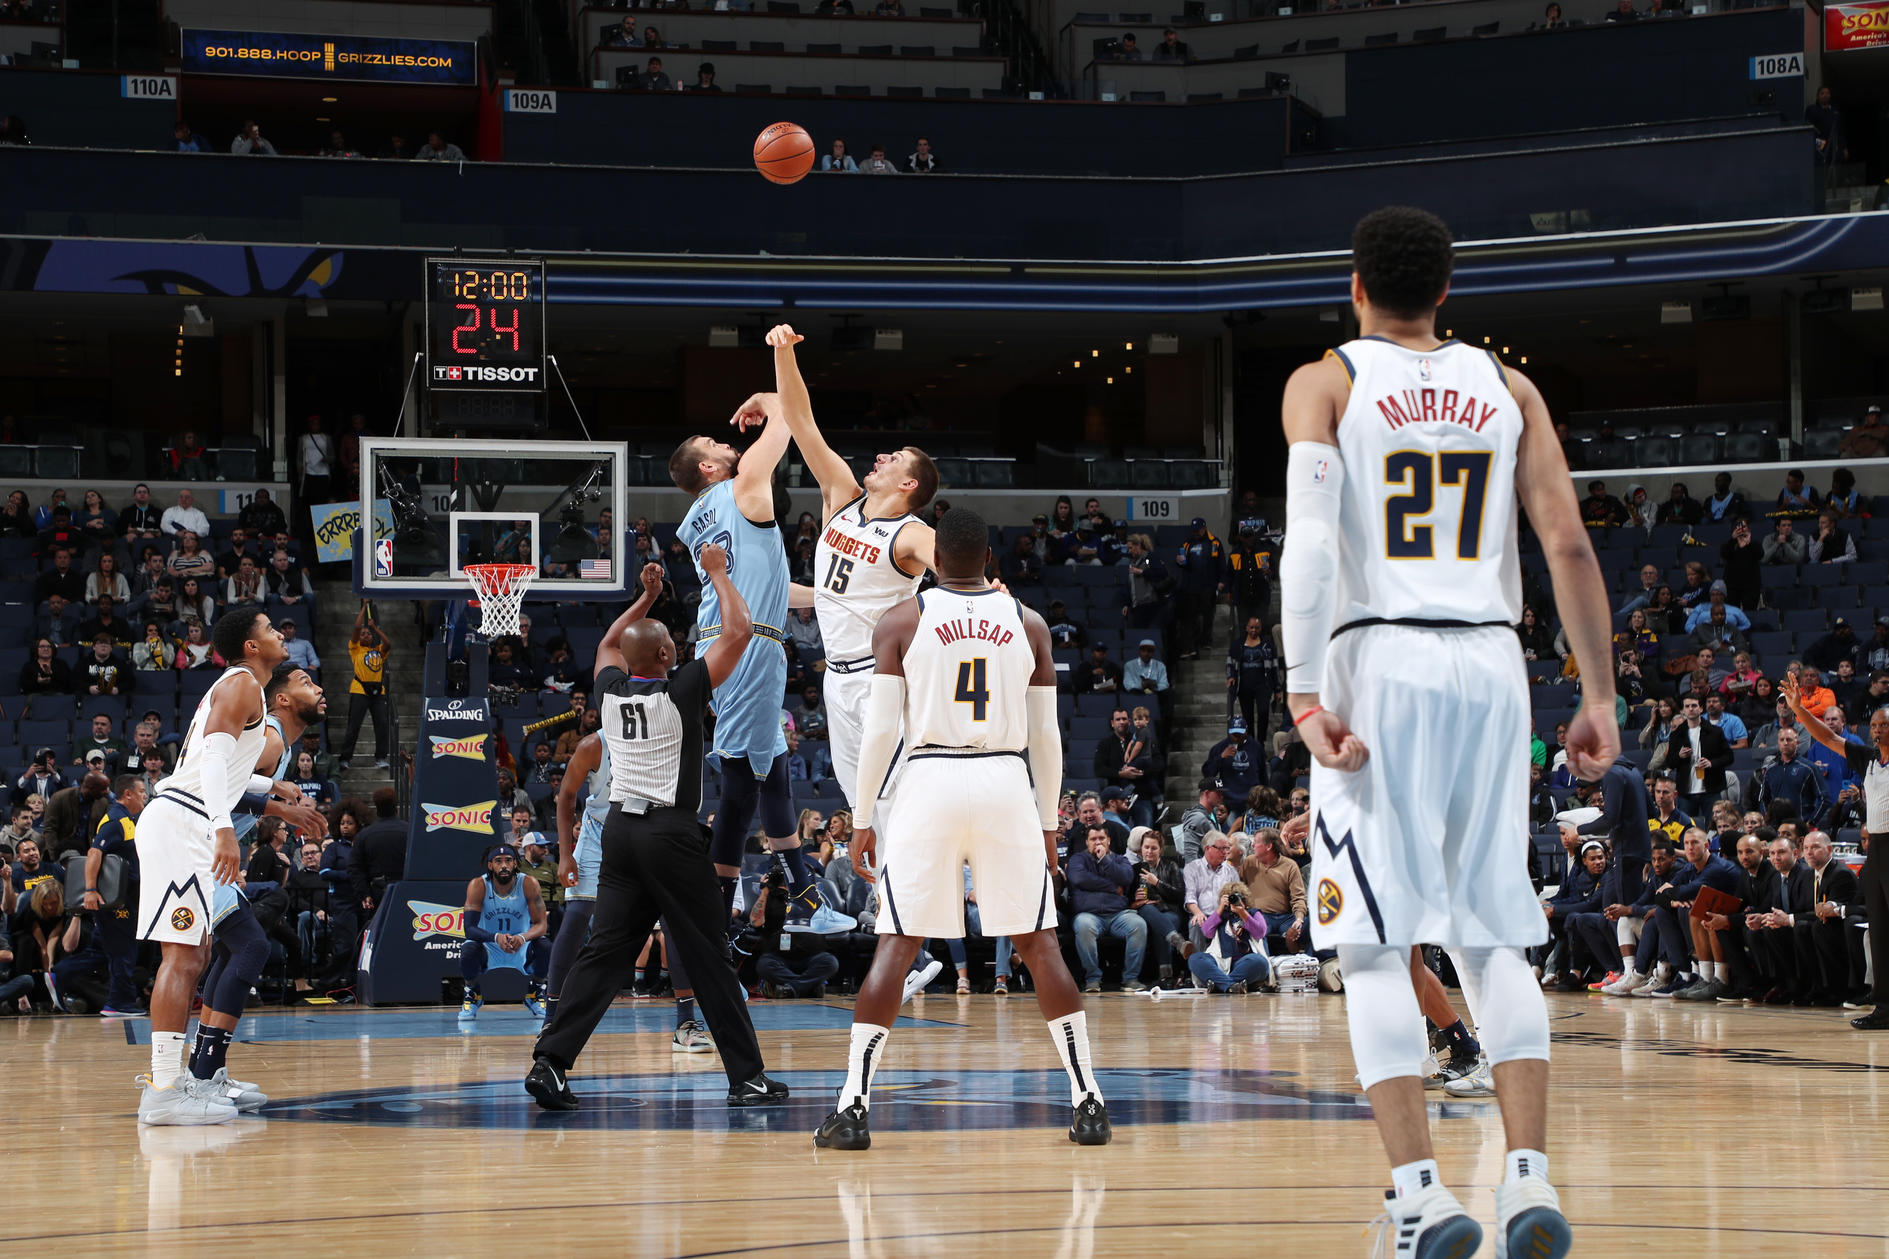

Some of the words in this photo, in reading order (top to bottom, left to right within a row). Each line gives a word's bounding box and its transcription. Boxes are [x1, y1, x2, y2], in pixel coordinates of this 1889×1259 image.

[205, 46, 321, 61] 901.888.HOOP
[338, 52, 452, 67] GRIZZLIES.COM
[1758, 56, 1801, 75] 108A
[131, 78, 172, 96] 110A
[512, 93, 552, 109] 109A
[454, 271, 527, 300] 12:00
[452, 303, 519, 354] 24
[463, 366, 538, 381] TISSOT
[1377, 388, 1498, 433] MURRAY
[236, 493, 252, 510] 11
[1142, 501, 1170, 517] 109
[1384, 448, 1495, 561] 27
[692, 508, 716, 535] GASOL
[823, 527, 880, 564] NUGGETS
[823, 553, 854, 594] 15
[935, 618, 1014, 647] MILLSAP
[953, 657, 991, 722] 4
[428, 708, 483, 721] SPALDING
[620, 702, 648, 739] 61
[435, 741, 484, 754] SONIC
[430, 810, 491, 826] SONIC
[484, 907, 522, 920] GRIZZLIES
[498, 918, 510, 930] 11
